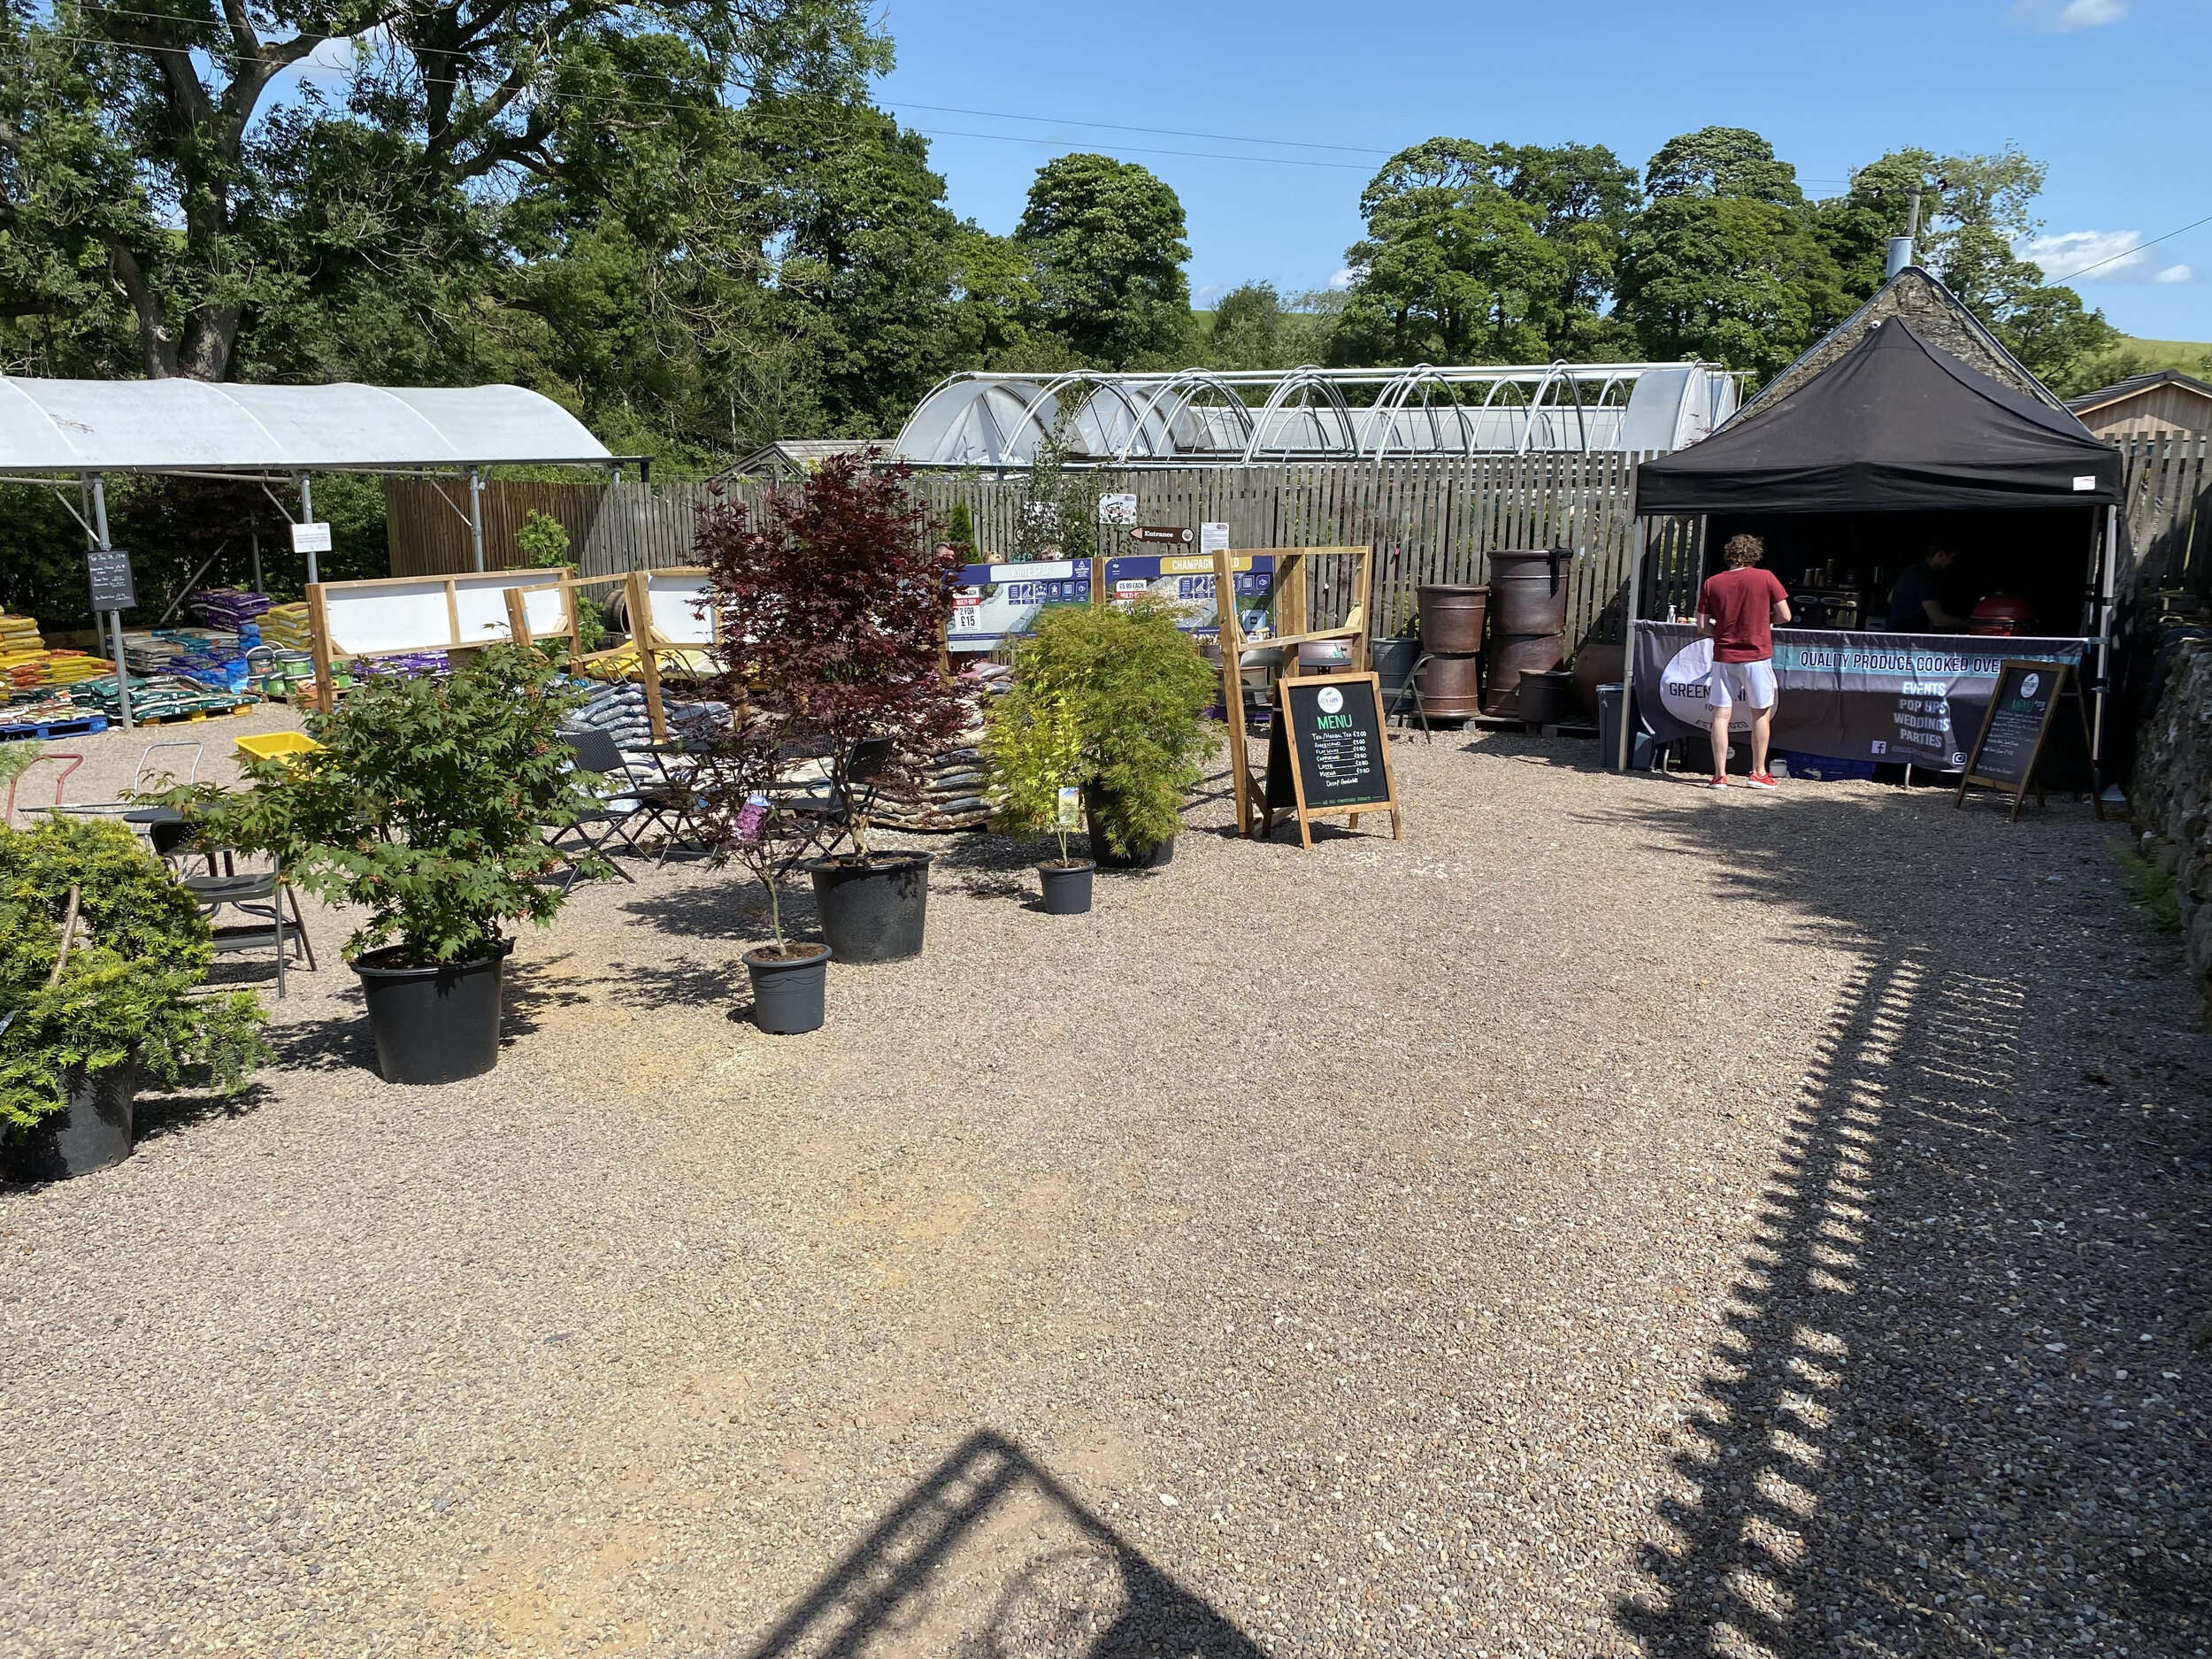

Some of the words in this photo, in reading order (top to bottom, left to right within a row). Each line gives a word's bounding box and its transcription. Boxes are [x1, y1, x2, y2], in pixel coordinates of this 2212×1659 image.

[1144, 530, 1174, 539] Entrance
[1171, 557, 1214, 571] CHAMPAGN
[1010, 566, 1033, 578] WHITE
[960, 607, 964, 616] 2
[964, 606, 975, 615] FOR
[960, 616, 976, 626] £15
[1801, 651, 1849, 669] QUALITY
[1854, 654, 1913, 672] PRODUCE
[1916, 657, 1969, 672] COOKED
[1669, 682, 1712, 699] GREEN
[1902, 681, 1947, 696] EVENTS
[1899, 698, 1922, 712] POP
[1924, 700, 1947, 714] UPS
[1317, 714, 1353, 730] MENU
[1728, 720, 1749, 730] 020
[1893, 712, 1951, 732] WEDDINGS
[1900, 727, 1943, 748] PARTIES
